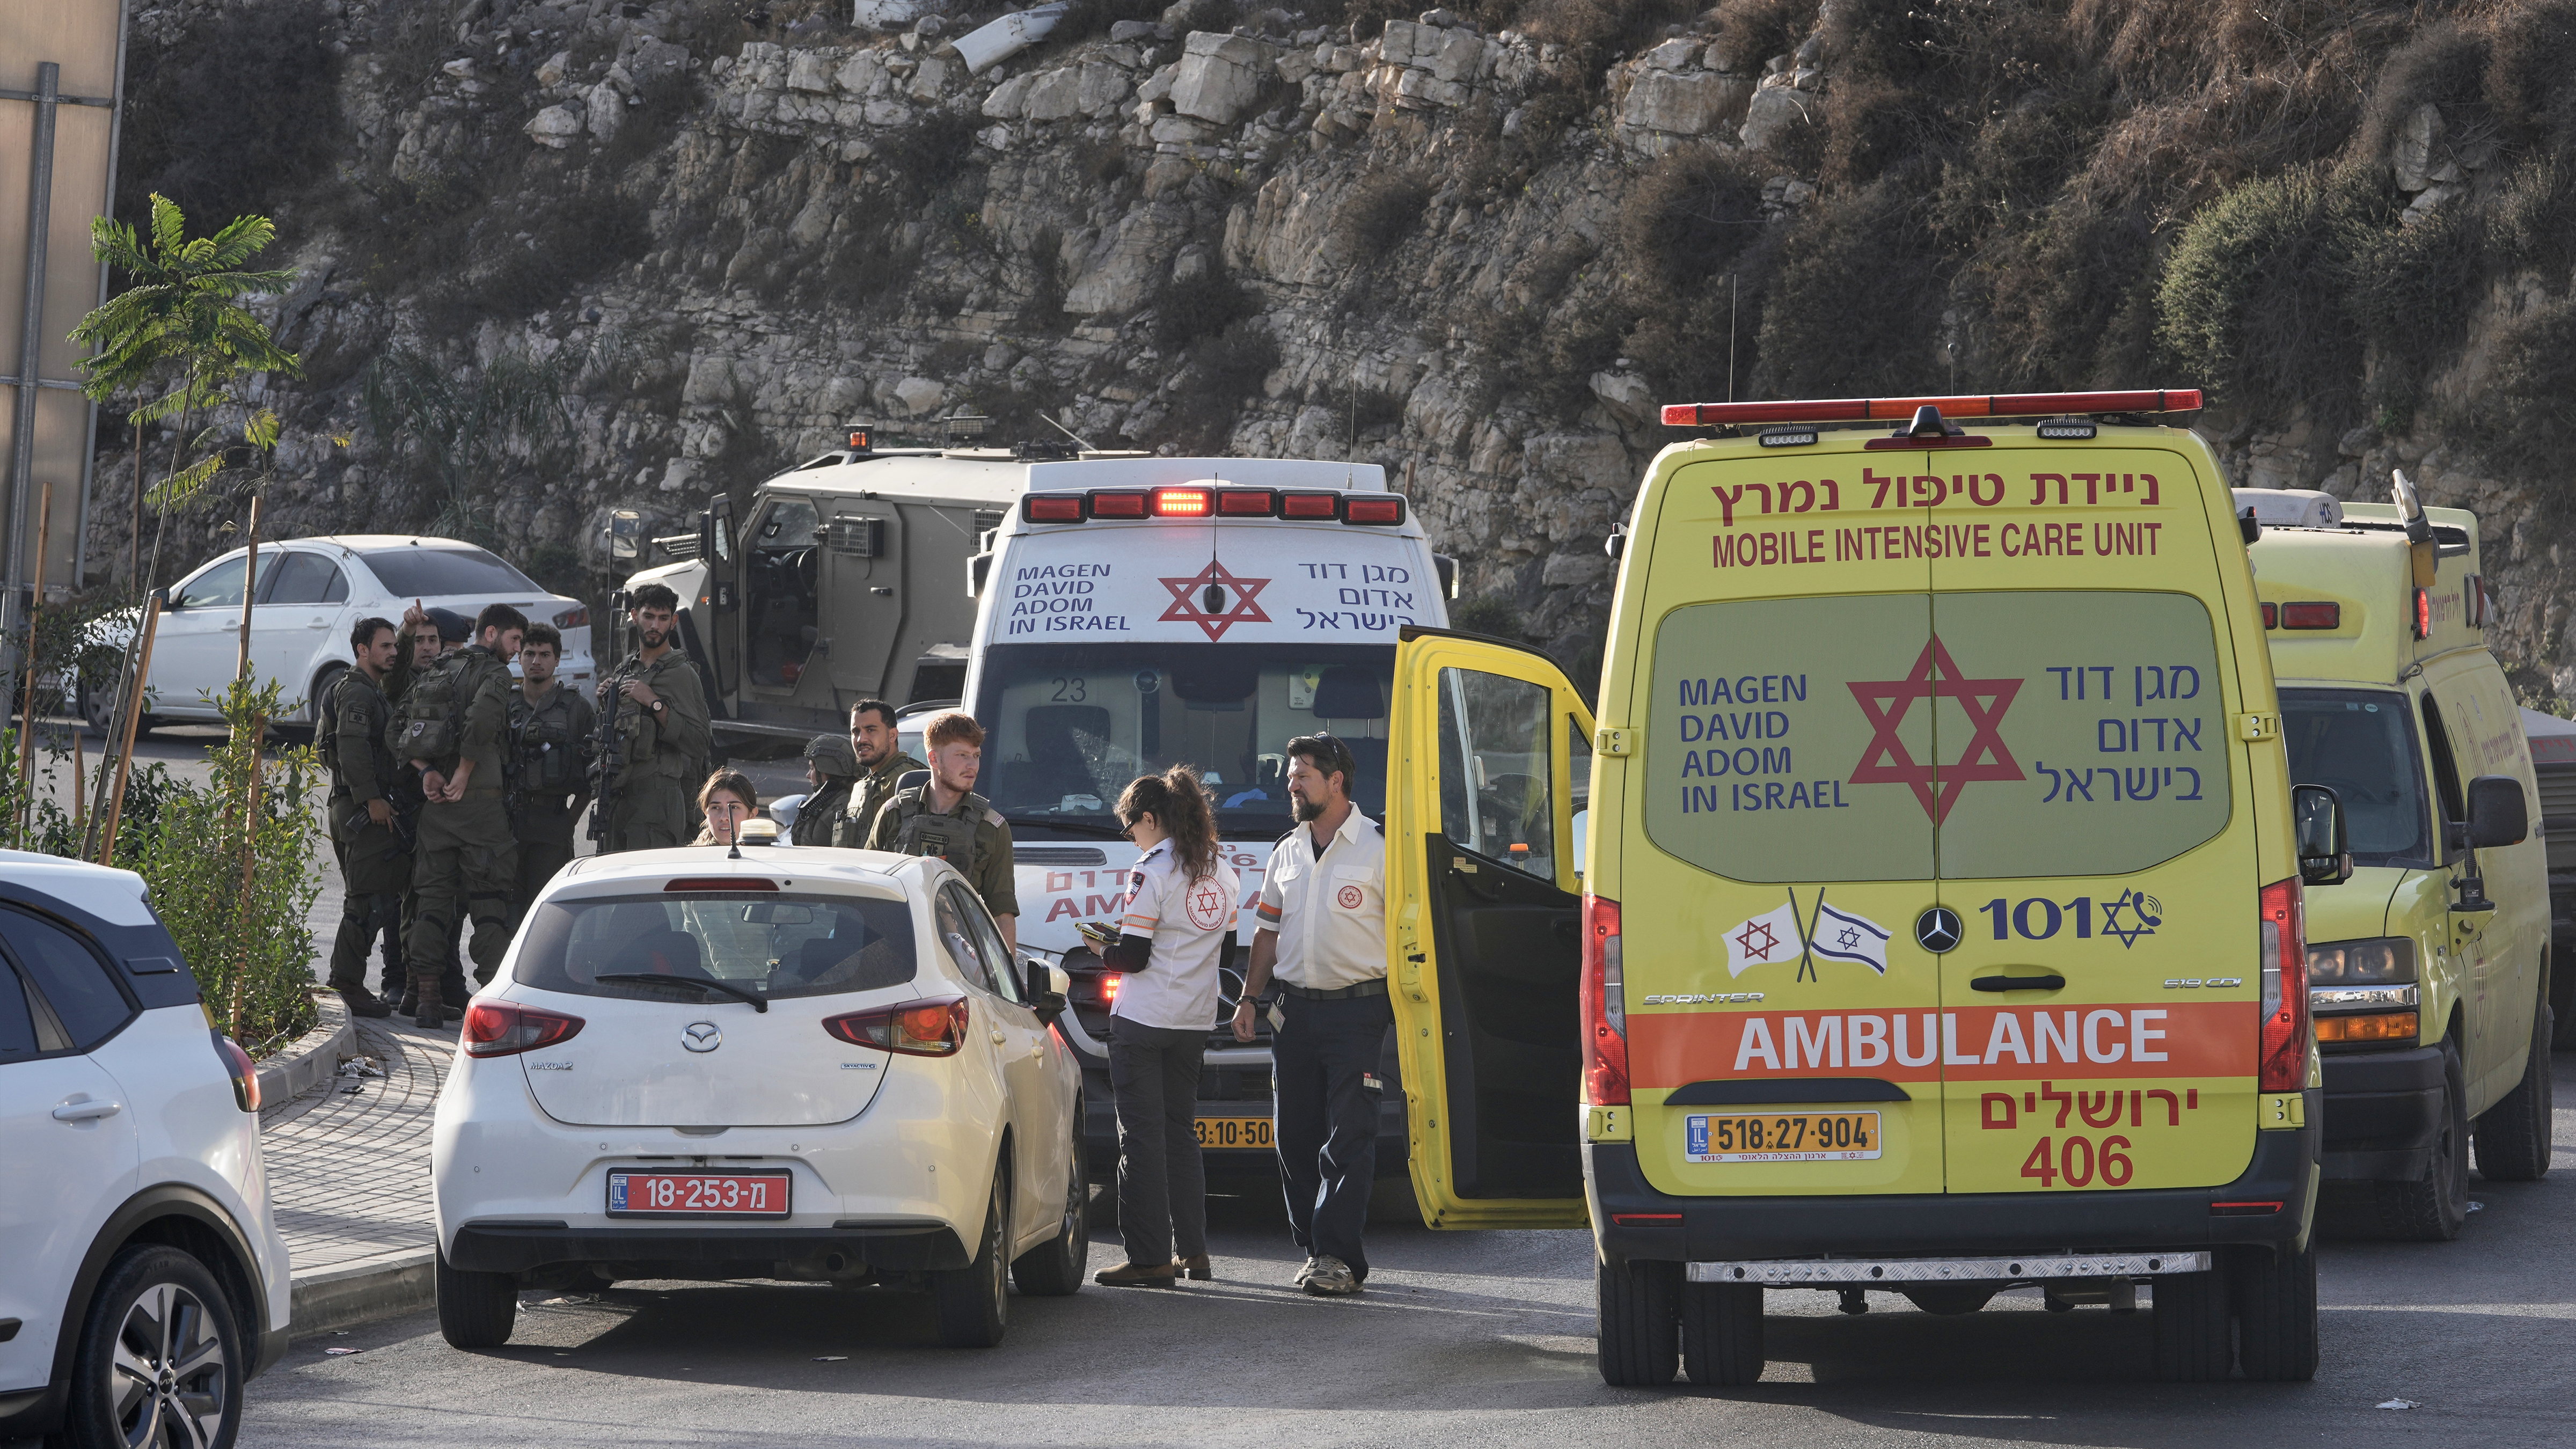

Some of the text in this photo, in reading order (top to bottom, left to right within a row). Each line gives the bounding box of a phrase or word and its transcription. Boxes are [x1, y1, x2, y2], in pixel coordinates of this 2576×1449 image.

[1711, 467, 2160, 526] ניידת טיפול נמרץ
[1712, 522, 2162, 569] MOBILE INTENSIVE CARE UNIT
[1017, 564, 1111, 581] MAGEN
[1298, 564, 1410, 584] מגן דוד
[1014, 581, 1094, 598] DAVID
[1339, 588, 1415, 610] אדום
[1011, 598, 1093, 617] ADOM
[1009, 616, 1131, 635] IN ISRAEL
[1051, 677, 1087, 702] 23
[1680, 674, 1807, 707] MAGEN
[2046, 664, 2201, 707] מגן דוד
[1680, 711, 1790, 743] DAVID
[2098, 716, 2203, 753] אדום
[2528, 738, 2575, 754] נייד
[1681, 747, 1792, 778] ADOM
[2036, 760, 2204, 804] בישראל
[1682, 781, 1850, 815] IN ISRAEL
[1046, 869, 1131, 893] דום
[1189, 906, 1198, 921] MAGEN
[1197, 920, 1208, 928] DAVID
[1979, 897, 2091, 940] 101
[2163, 977, 2242, 989] 519 CDI
[1643, 992, 1765, 1005] SPRINTER
[1733, 1009, 2170, 1071] AMBULANCE
[1981, 1081, 2199, 1130] ירושלים
[1694, 1128, 1705, 1143] IL
[2020, 1135, 2134, 1187] 406
[614, 1186, 624, 1199] IL
